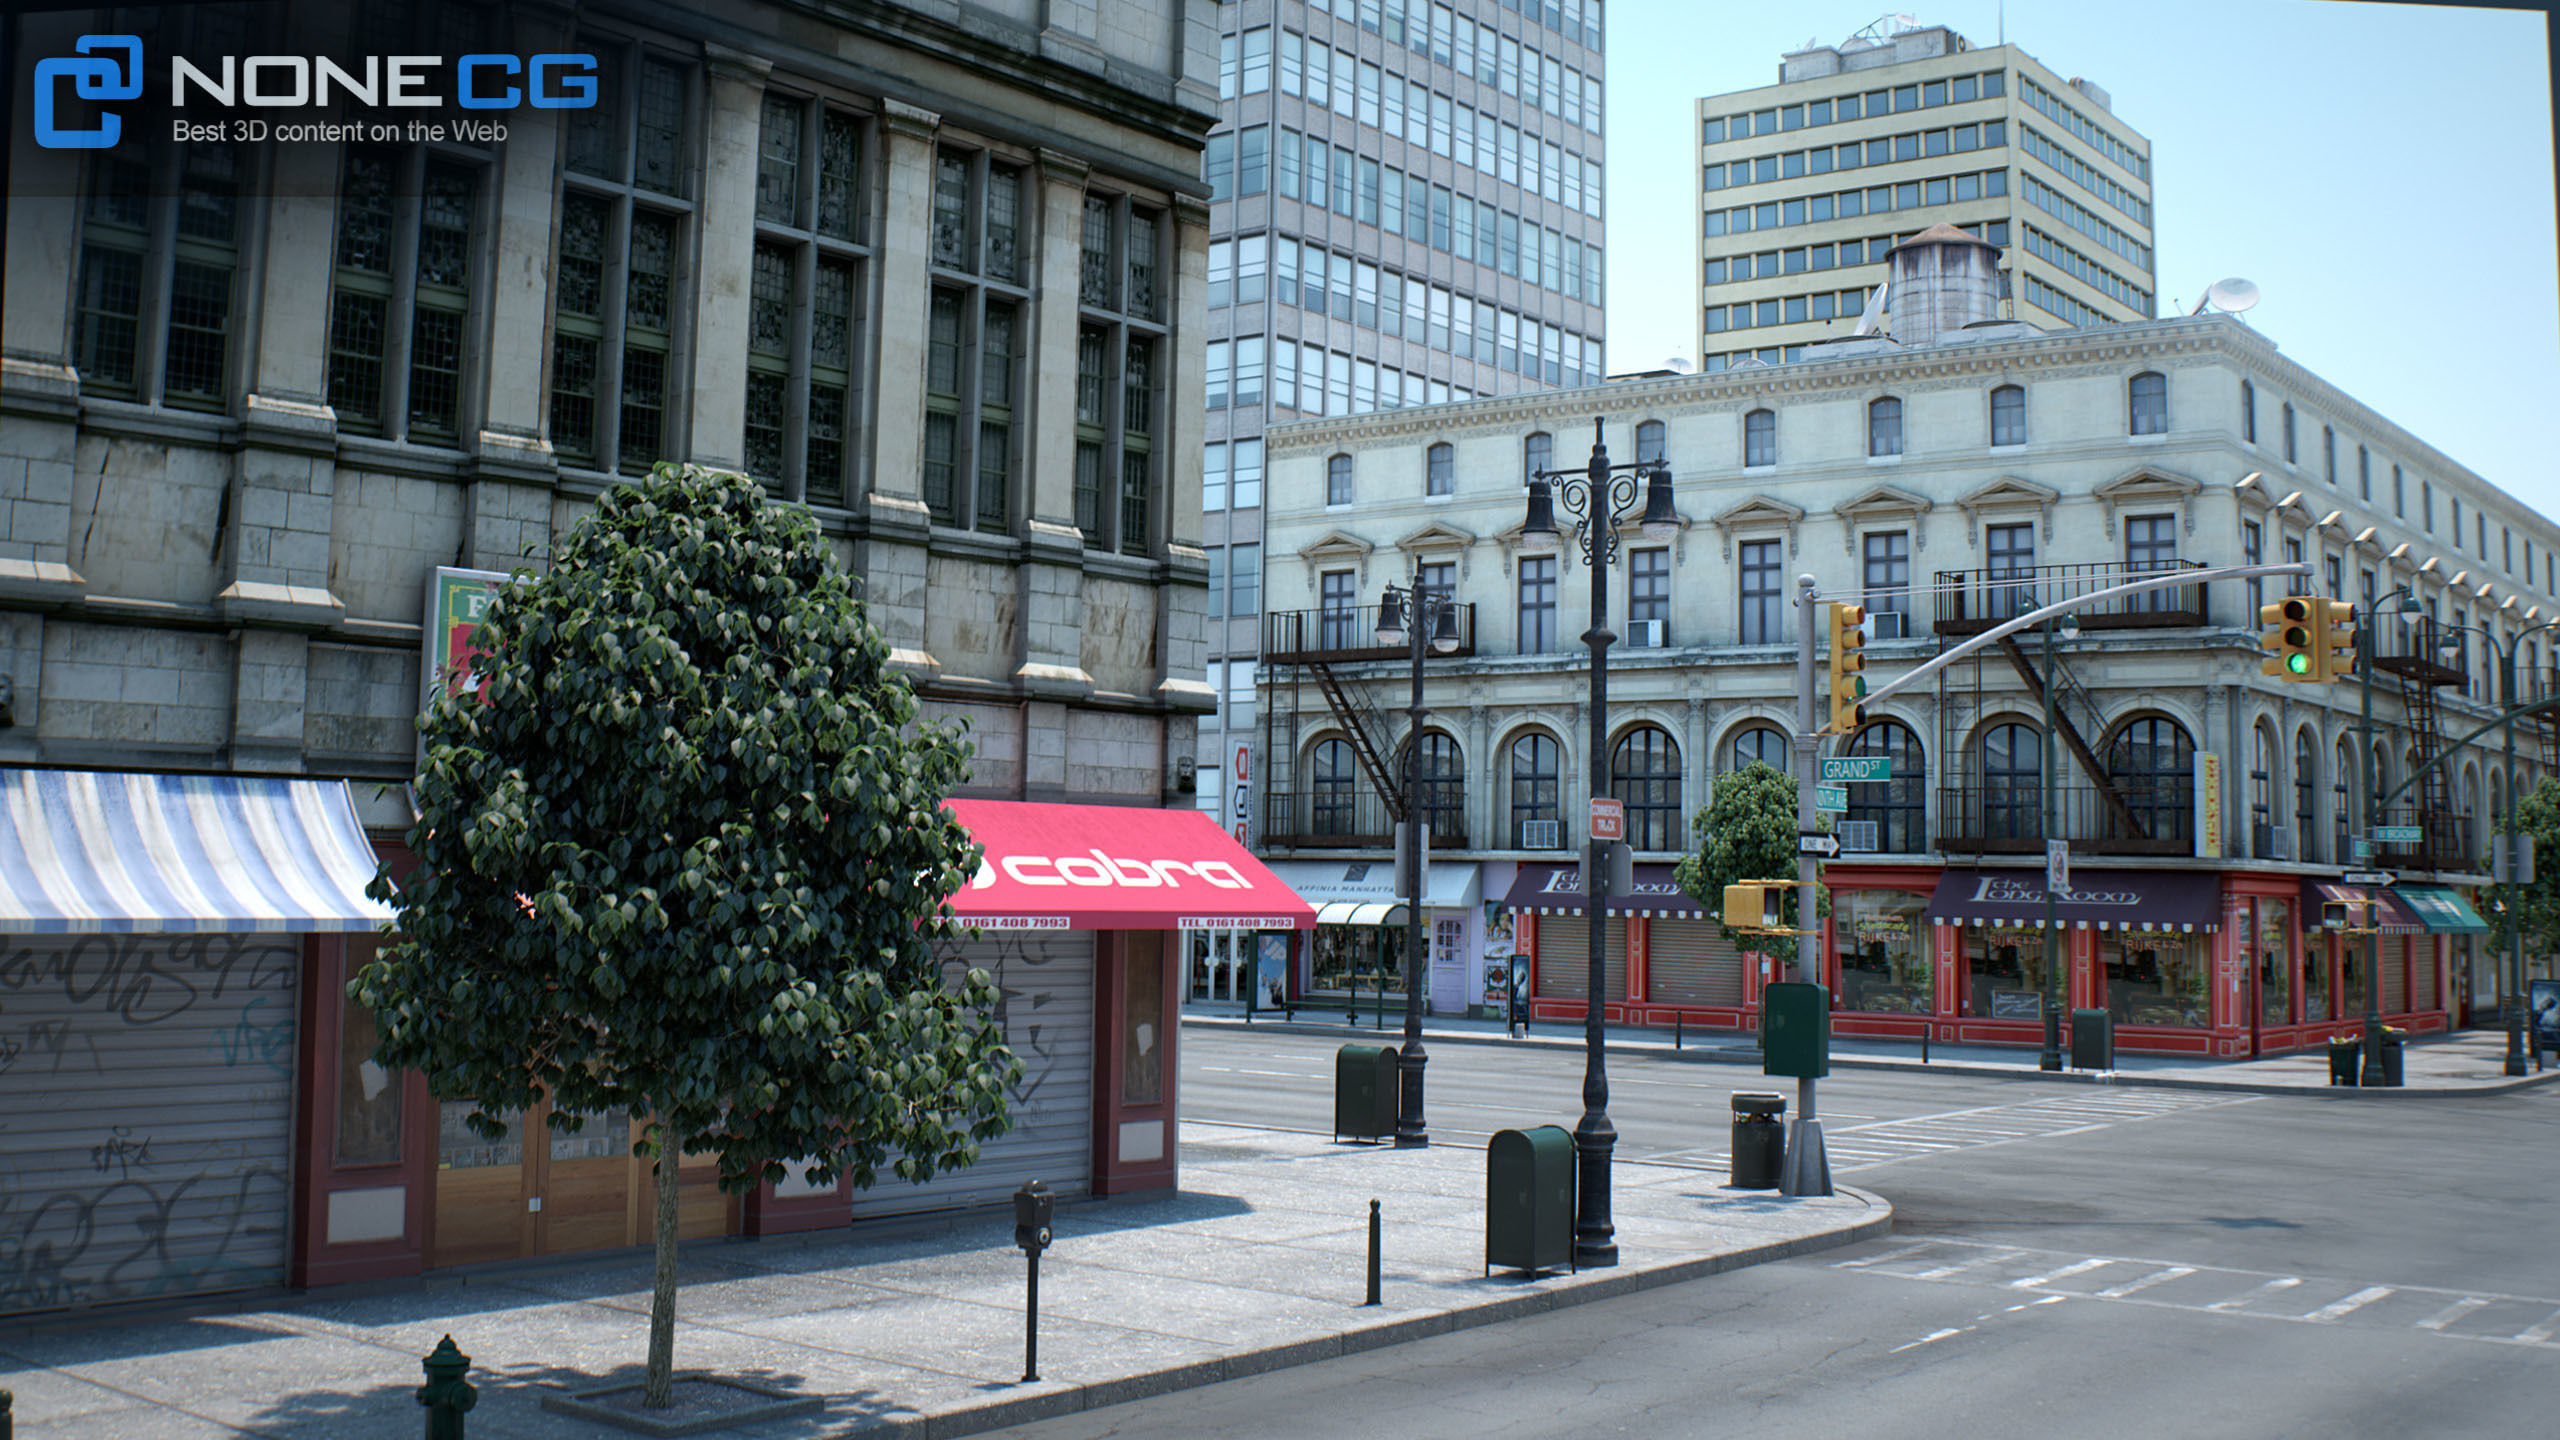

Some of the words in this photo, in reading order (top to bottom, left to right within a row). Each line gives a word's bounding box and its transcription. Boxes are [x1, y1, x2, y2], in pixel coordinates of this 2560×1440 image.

[1824, 760, 1870, 778] GRAND
[1871, 760, 1881, 770] ST
[1804, 838, 1817, 849] ONE
[1001, 849, 1254, 888] cobra
[963, 918, 997, 928] 0161
[1000, 918, 1029, 928] 408
[1032, 918, 1068, 928] 7993
[1182, 918, 1204, 928] TEL.
[1207, 918, 1235, 928] 0161
[1236, 918, 1260, 928] 408
[1263, 918, 1293, 928] 7993
